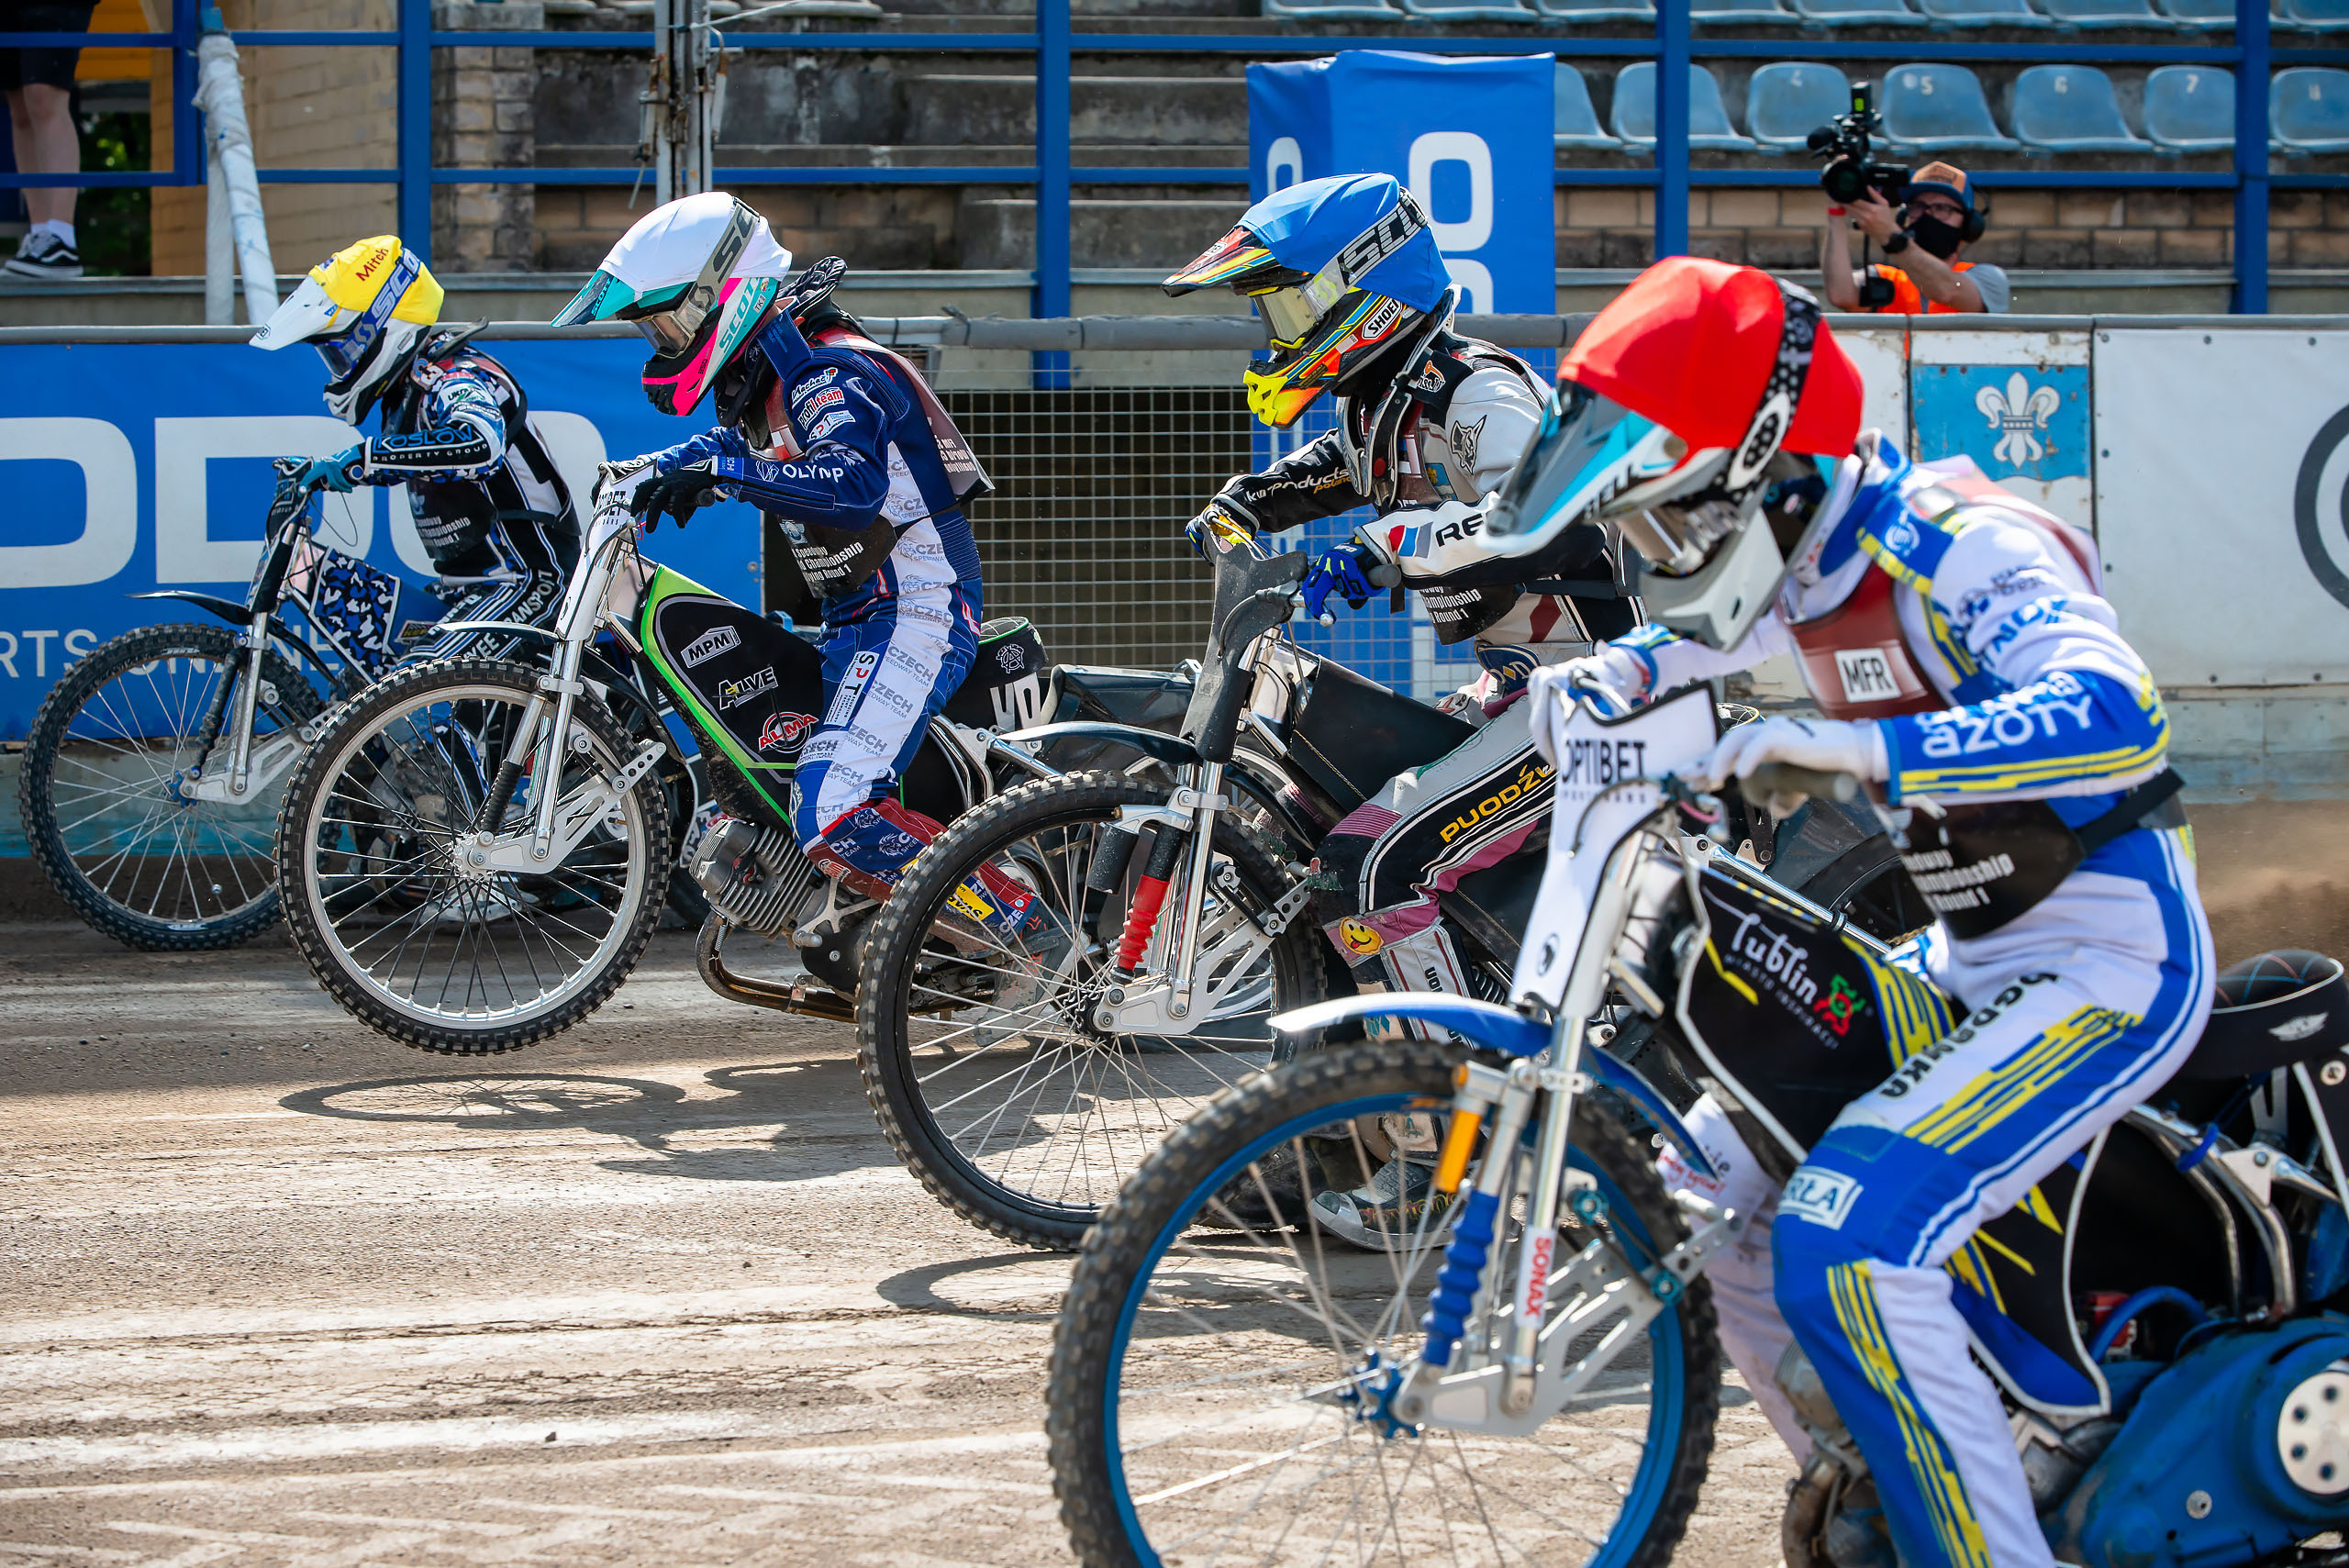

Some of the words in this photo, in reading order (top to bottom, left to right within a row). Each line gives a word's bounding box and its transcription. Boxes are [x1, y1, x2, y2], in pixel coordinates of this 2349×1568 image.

[2187, 74, 2199, 93] 7
[355, 248, 389, 282] Mitch
[372, 424, 473, 454] KOSLOW
[373, 449, 440, 462] PROPERTY
[447, 443, 488, 457] GROUP
[1435, 513, 1485, 548] RE
[807, 540, 864, 570] Championship
[915, 543, 944, 555] CZE
[824, 566, 846, 580] Round
[1424, 587, 1483, 609] hampionship
[913, 605, 953, 623] CZEC
[1433, 608, 1463, 624] Round
[688, 632, 731, 662] MPM
[887, 645, 935, 683] CZECH
[1842, 657, 1894, 693] MFR
[758, 714, 819, 751] ALMA
[847, 723, 888, 752] ZECH
[830, 762, 865, 783] ECH
[999, 909, 1024, 934] CZE
[1523, 1235, 1553, 1318] SONAX
